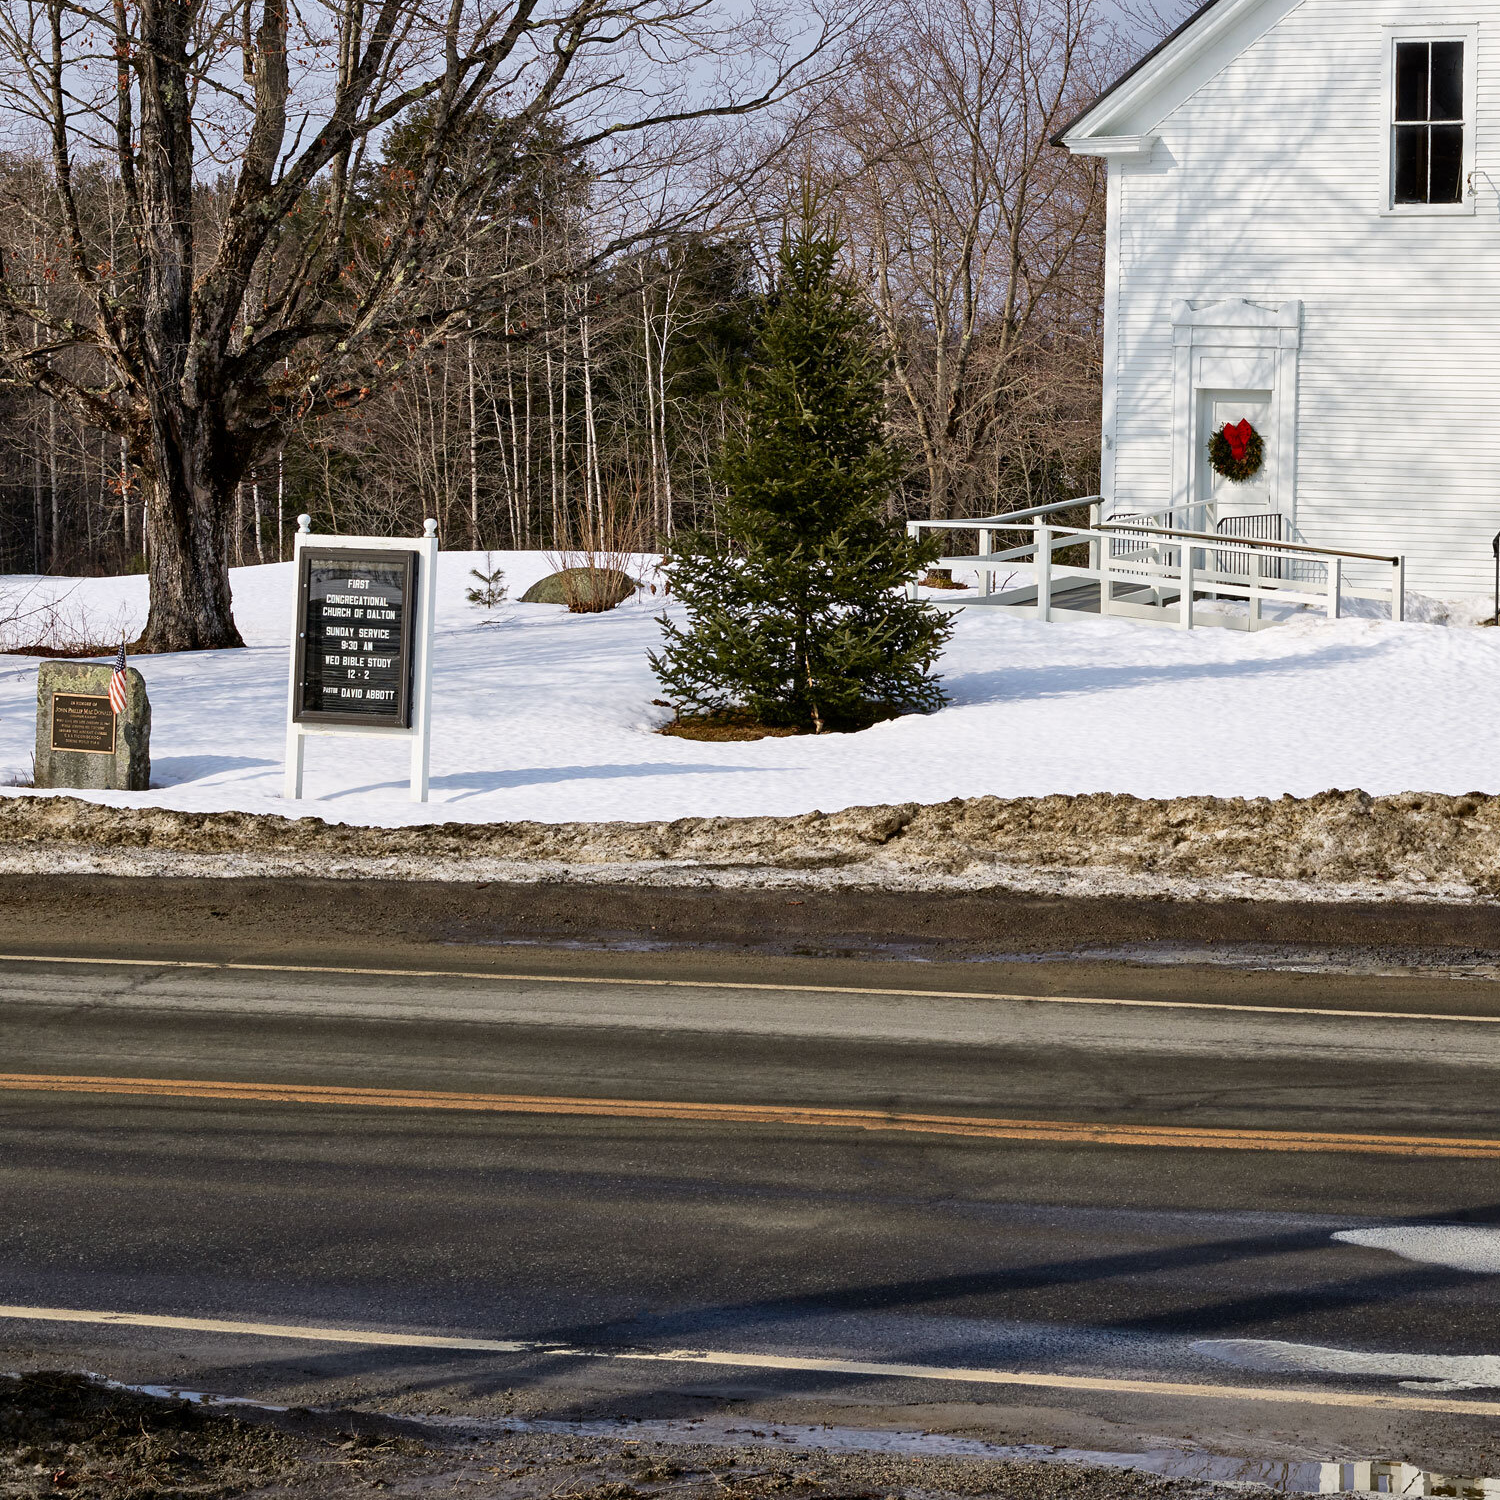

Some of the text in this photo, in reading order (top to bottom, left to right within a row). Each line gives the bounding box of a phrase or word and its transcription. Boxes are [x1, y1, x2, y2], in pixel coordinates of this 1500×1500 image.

[347, 579, 370, 589] FIRST
[326, 594, 389, 607] CONGREGATIONAL
[322, 606, 396, 620] CHURCH OF DALTON
[325, 626, 390, 639] SUNDAY SERVICE
[341, 640, 373, 651] 9:30 AM
[325, 655, 392, 668] WED BIBLE STUDY
[347, 669, 356, 679] 12
[364, 670, 370, 679] 2
[341, 688, 363, 699] DAVID
[366, 689, 395, 700] ABBOTT
